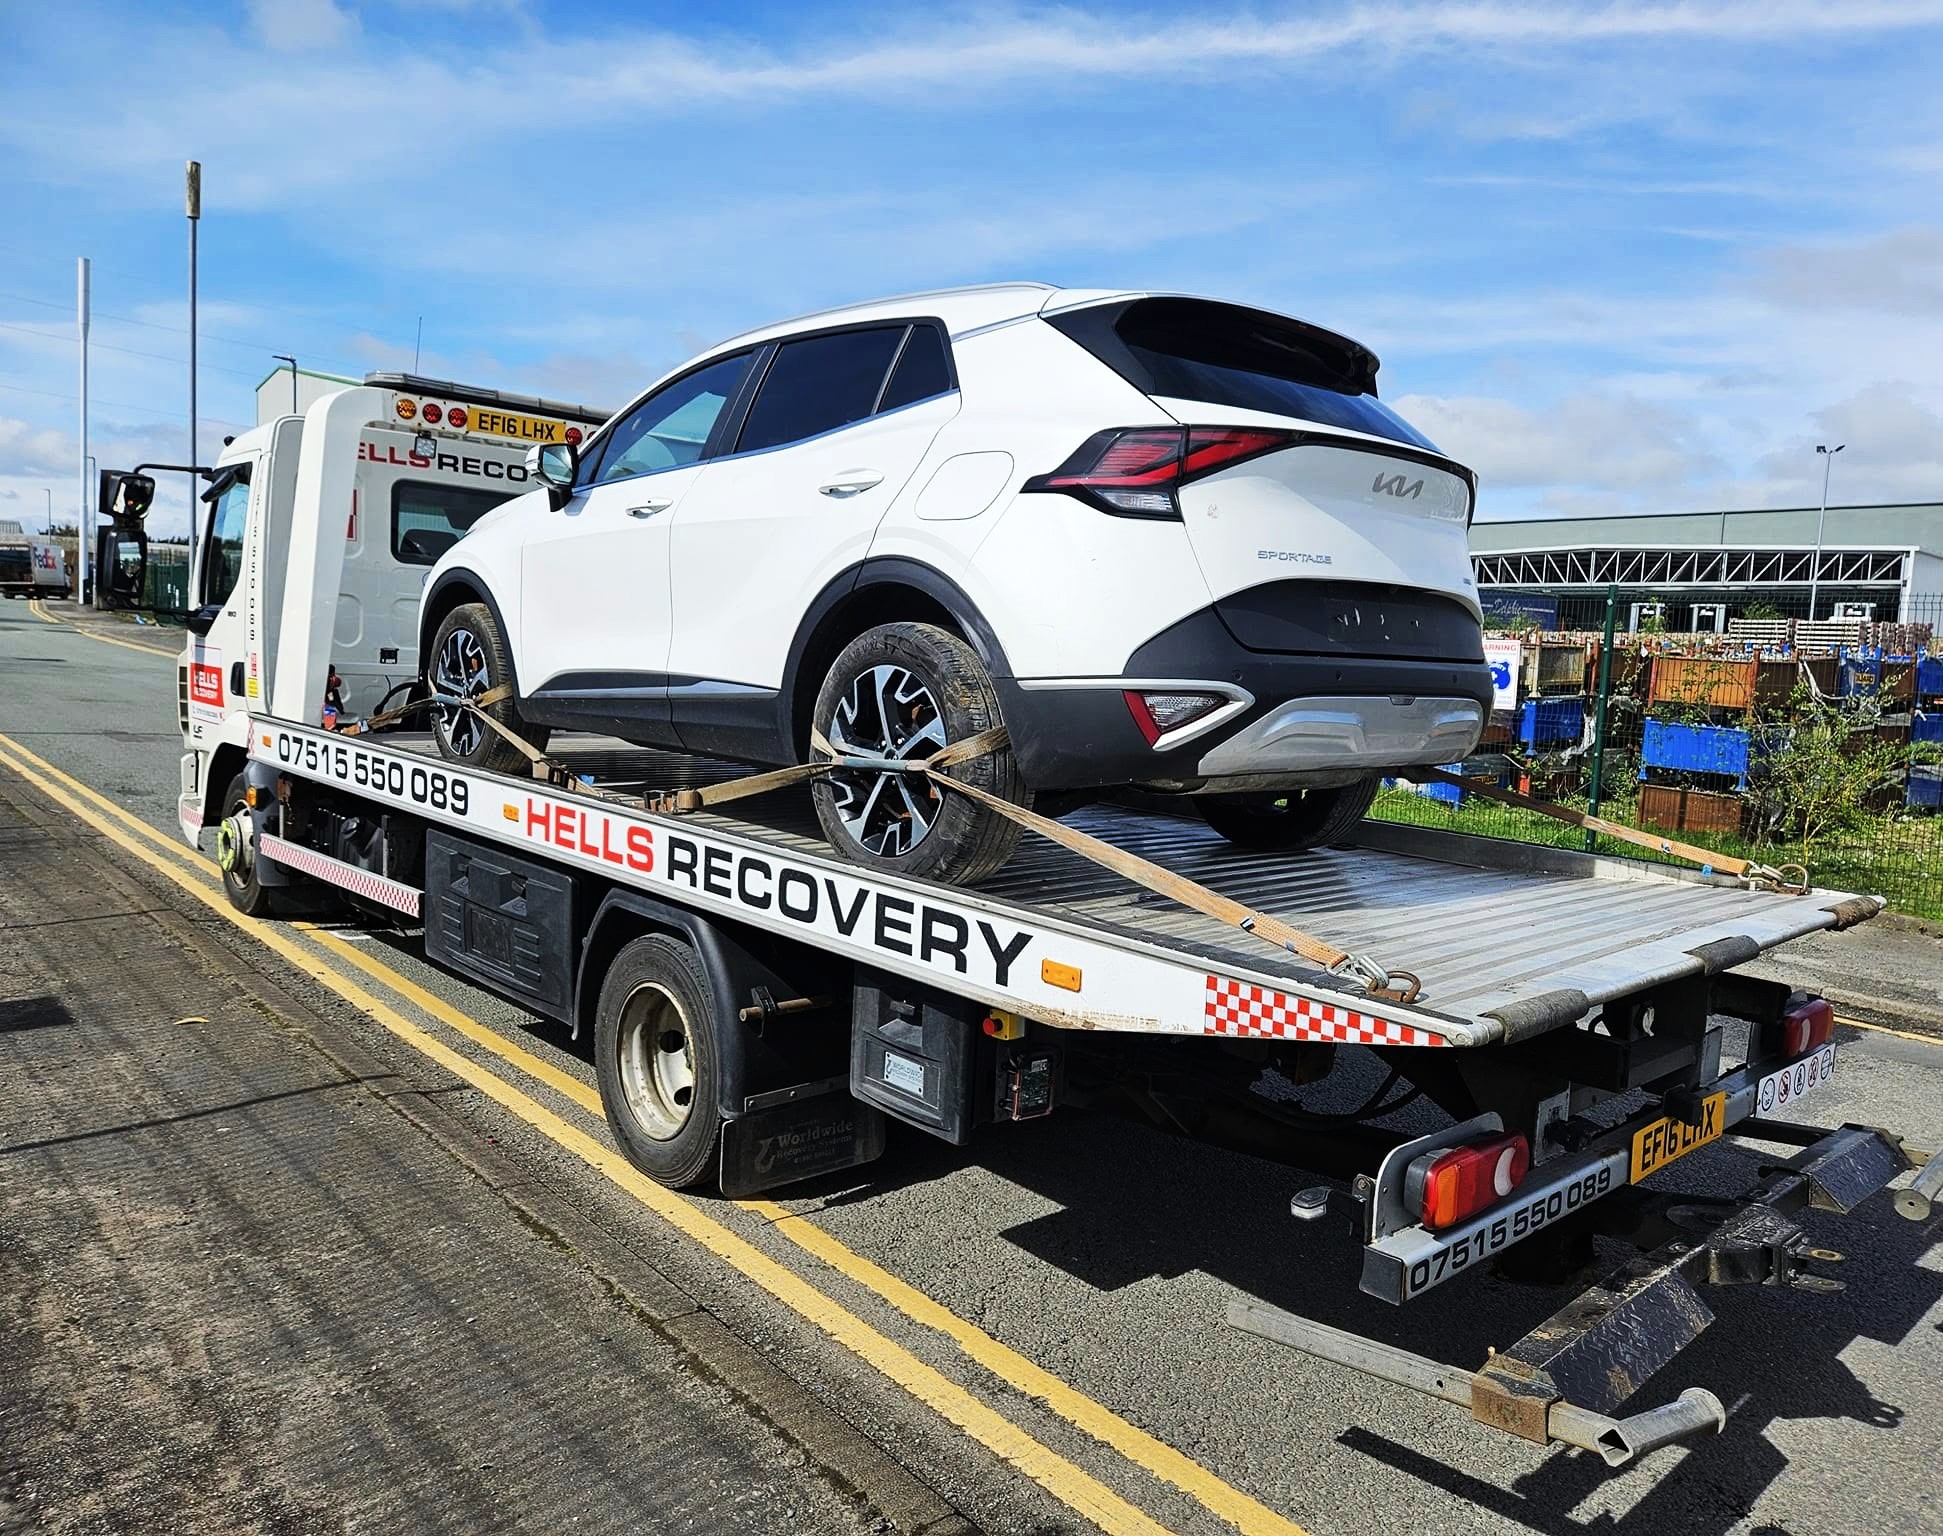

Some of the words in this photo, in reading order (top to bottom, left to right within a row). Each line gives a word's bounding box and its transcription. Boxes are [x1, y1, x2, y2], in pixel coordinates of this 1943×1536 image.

[478, 412, 517, 435] EF16
[522, 419, 555, 441] LHX
[1372, 471, 1424, 500] KIA
[1257, 550, 1332, 564] SPORTAGE
[279, 733, 348, 779] 07515
[355, 752, 403, 796] 550
[411, 768, 469, 816] 089
[527, 798, 654, 873] HELLS
[668, 835, 1034, 987] RECOVERY
[778, 1119, 854, 1149] Worldwide
[1641, 1119, 1680, 1172] EF16
[1410, 1217, 1508, 1292] 07515
[1512, 1191, 1562, 1238] 550
[1566, 1166, 1610, 1209] 089
